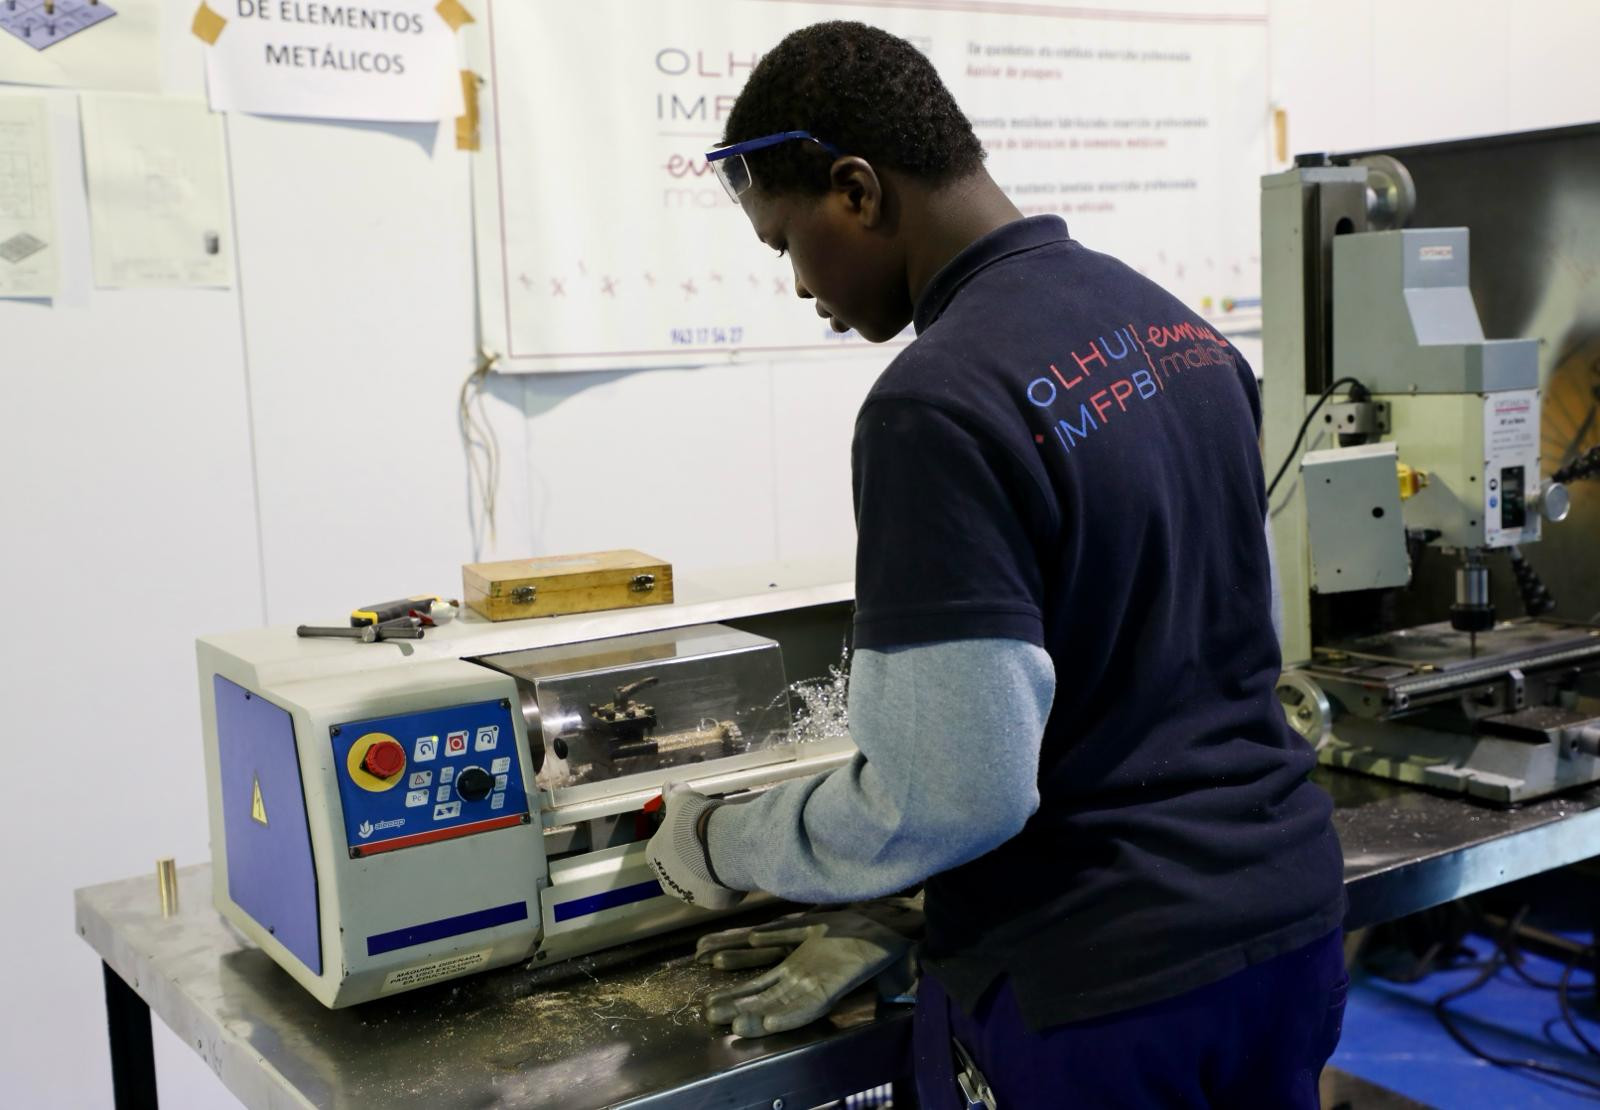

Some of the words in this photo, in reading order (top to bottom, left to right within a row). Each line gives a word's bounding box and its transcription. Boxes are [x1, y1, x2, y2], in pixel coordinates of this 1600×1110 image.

[237, 0, 271, 20] DE
[280, 1, 423, 34] ELEMENTOS
[265, 43, 405, 75] METÁLICOS
[656, 48, 758, 77] OLH
[657, 94, 738, 121] IMF
[1027, 327, 1138, 407] OLHUI
[1054, 369, 1157, 453] IMFPB
[390, 975, 413, 984] PARA
